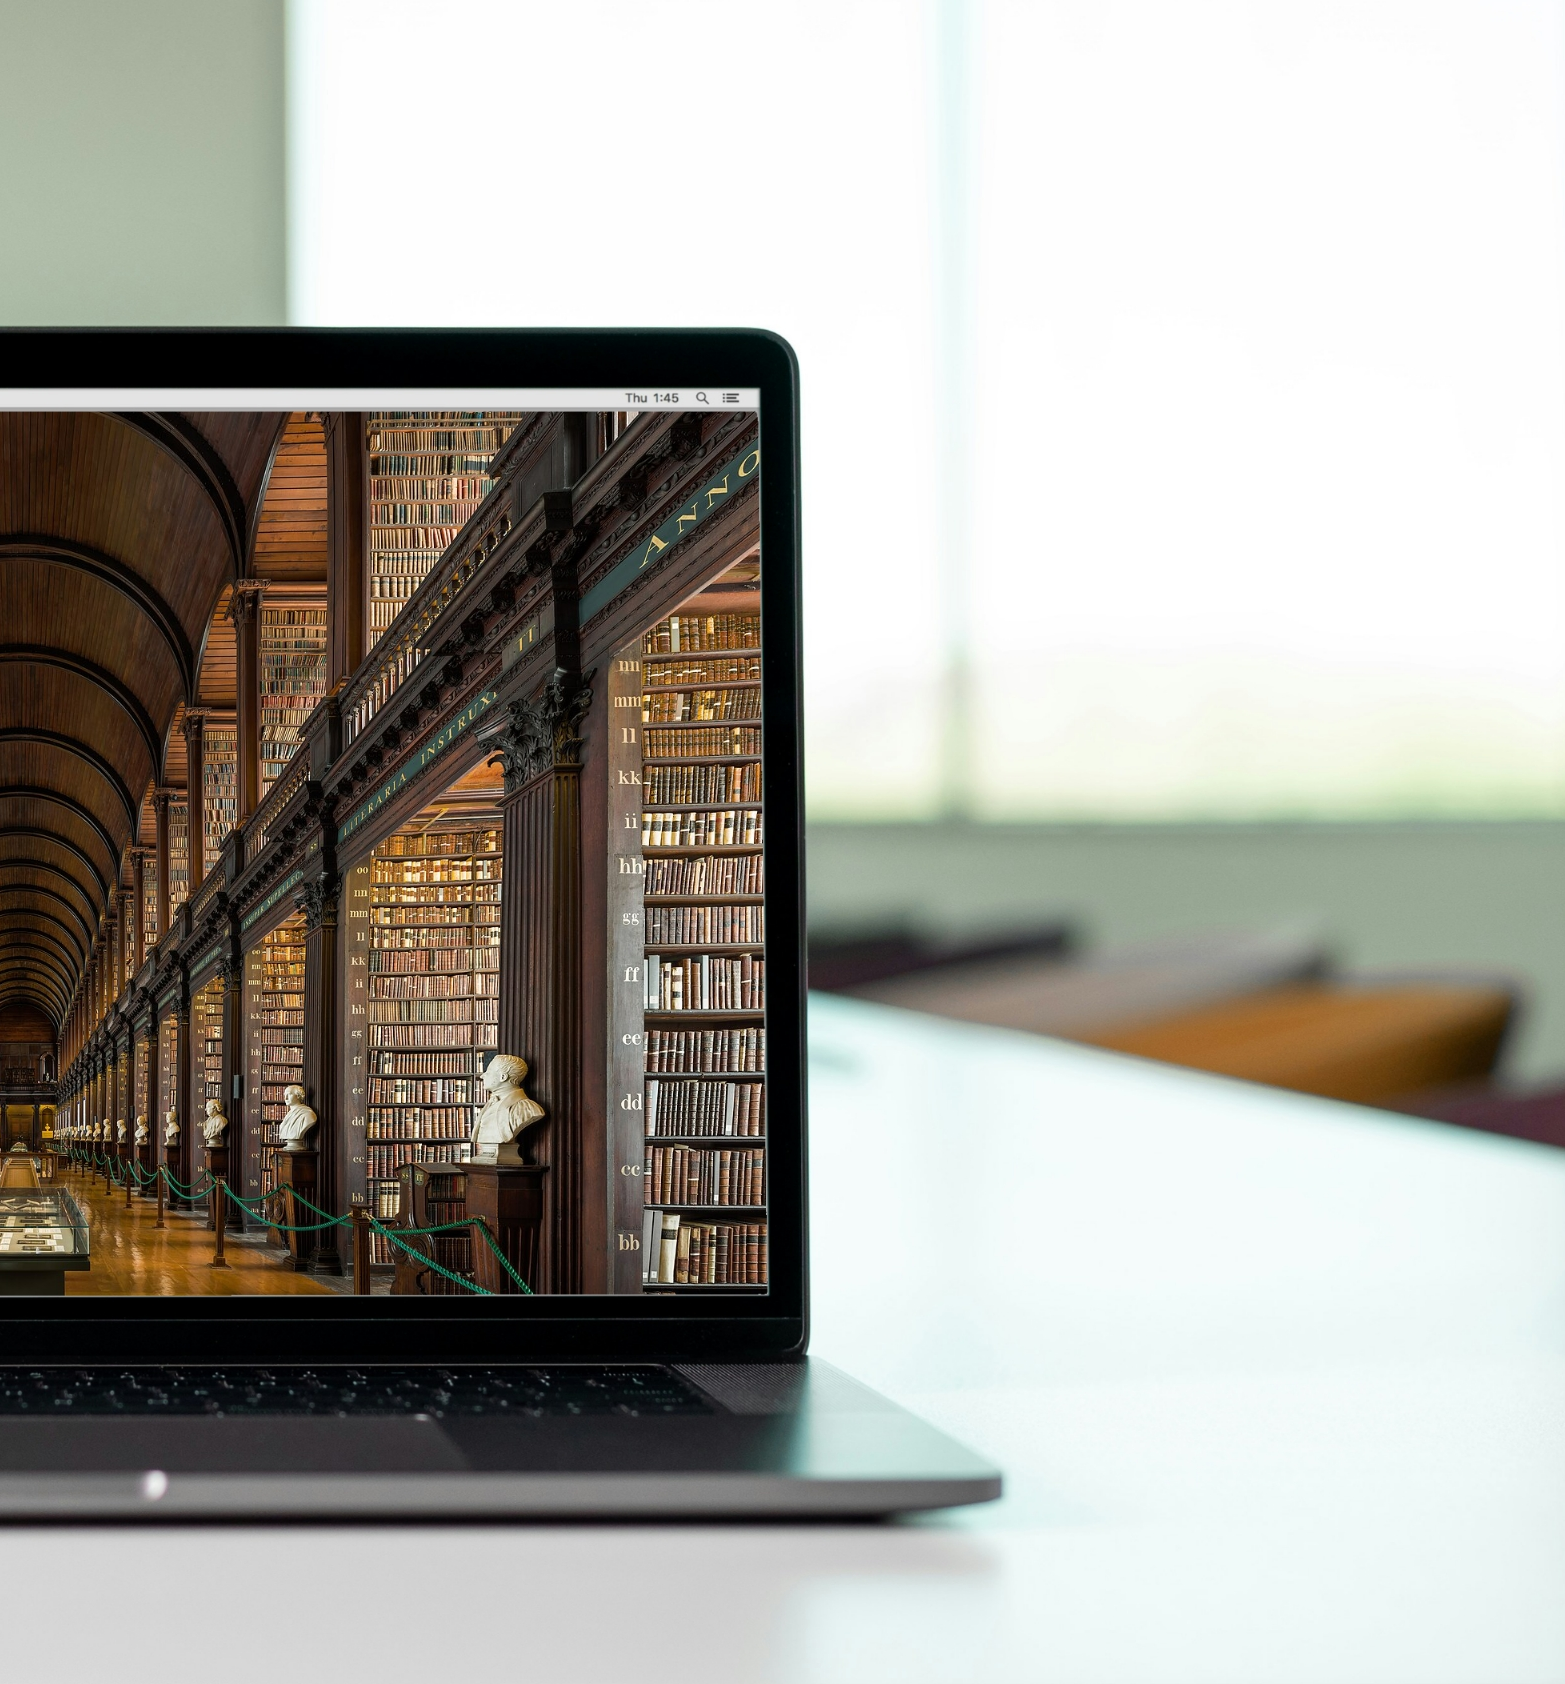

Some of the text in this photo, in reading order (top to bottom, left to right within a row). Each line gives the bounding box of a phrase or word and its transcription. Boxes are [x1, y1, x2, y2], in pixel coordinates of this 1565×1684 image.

[625, 392, 680, 403] Thu 1:45
[639, 449, 760, 569] ANNO
[618, 659, 640, 672] nn
[614, 696, 641, 708] mm
[618, 769, 641, 785] kk
[343, 772, 407, 837] LITERARIA
[624, 813, 638, 829] ii
[618, 857, 643, 875] hh
[622, 911, 640, 926] gg
[623, 966, 640, 982] ff
[622, 1032, 642, 1045] ee
[621, 1093, 643, 1111] dd
[621, 1164, 641, 1177] cc
[618, 1233, 640, 1252] bb
